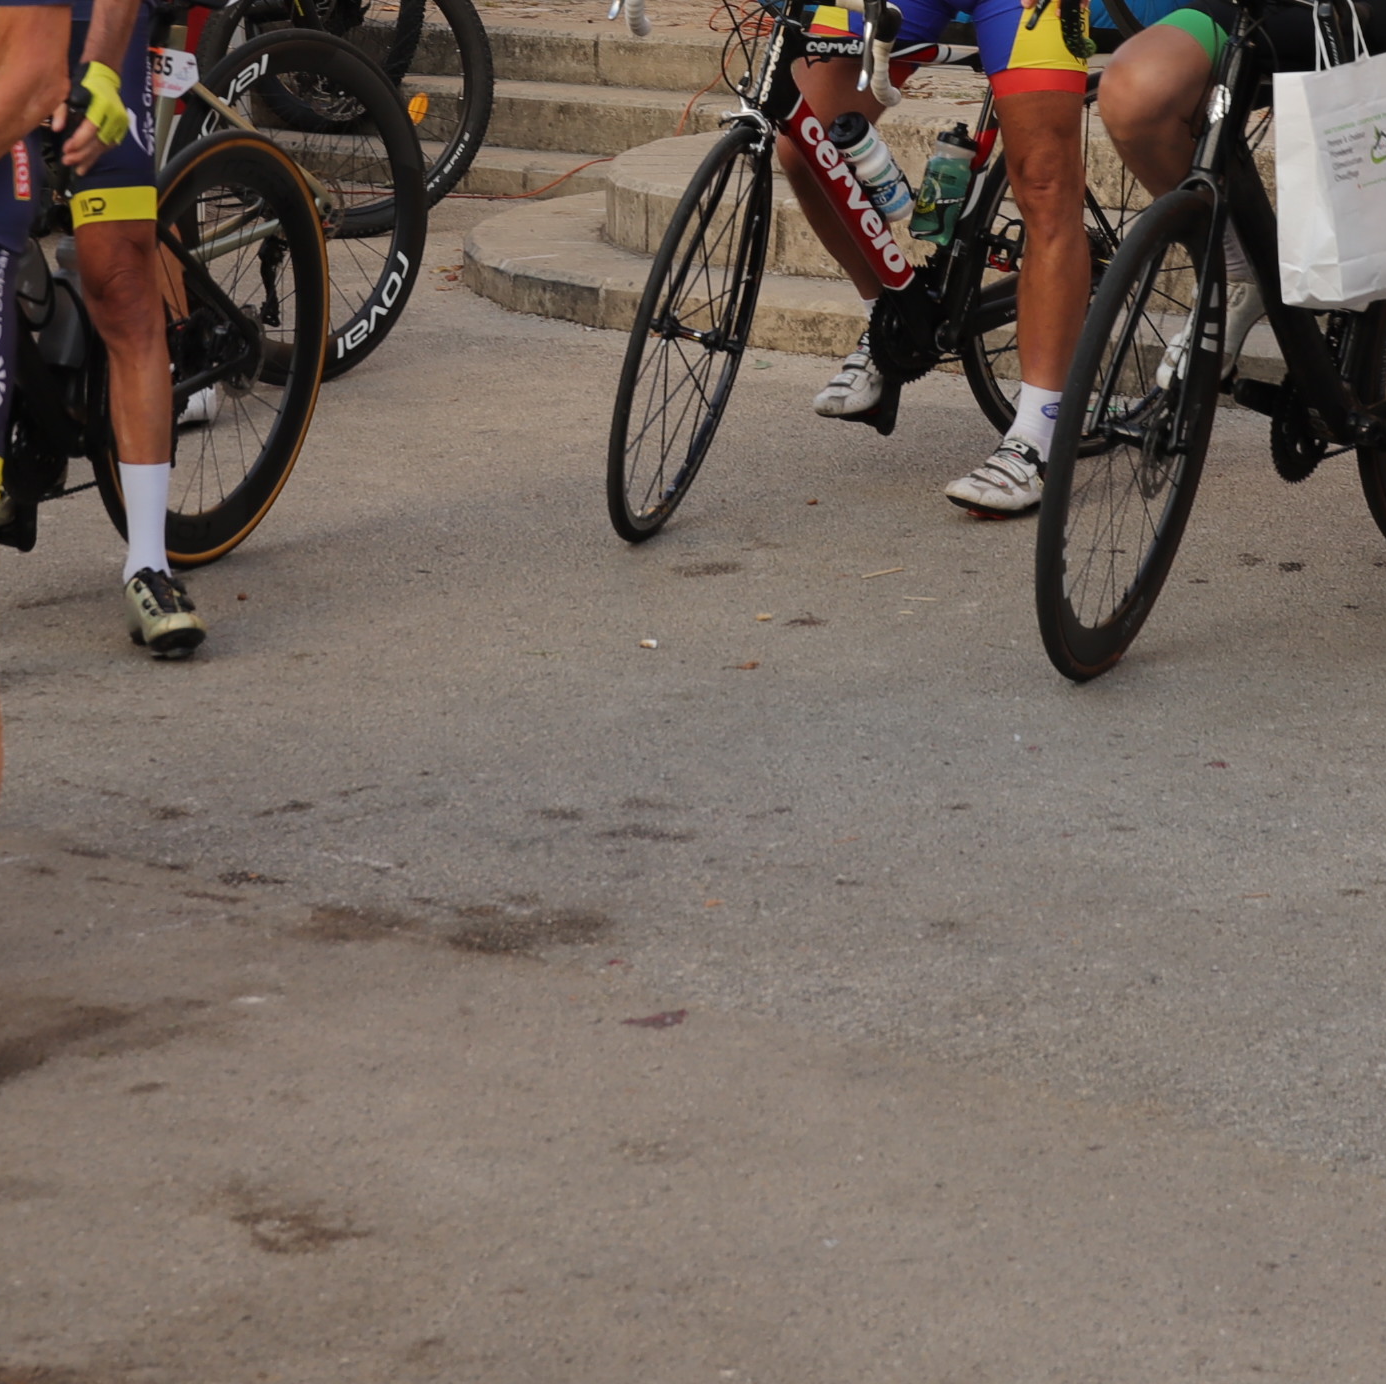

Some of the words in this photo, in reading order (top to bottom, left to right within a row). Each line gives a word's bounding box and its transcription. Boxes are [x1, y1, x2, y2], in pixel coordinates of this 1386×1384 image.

[806, 38, 863, 56] cervél
[198, 54, 269, 140] oval
[337, 251, 409, 358] roval
